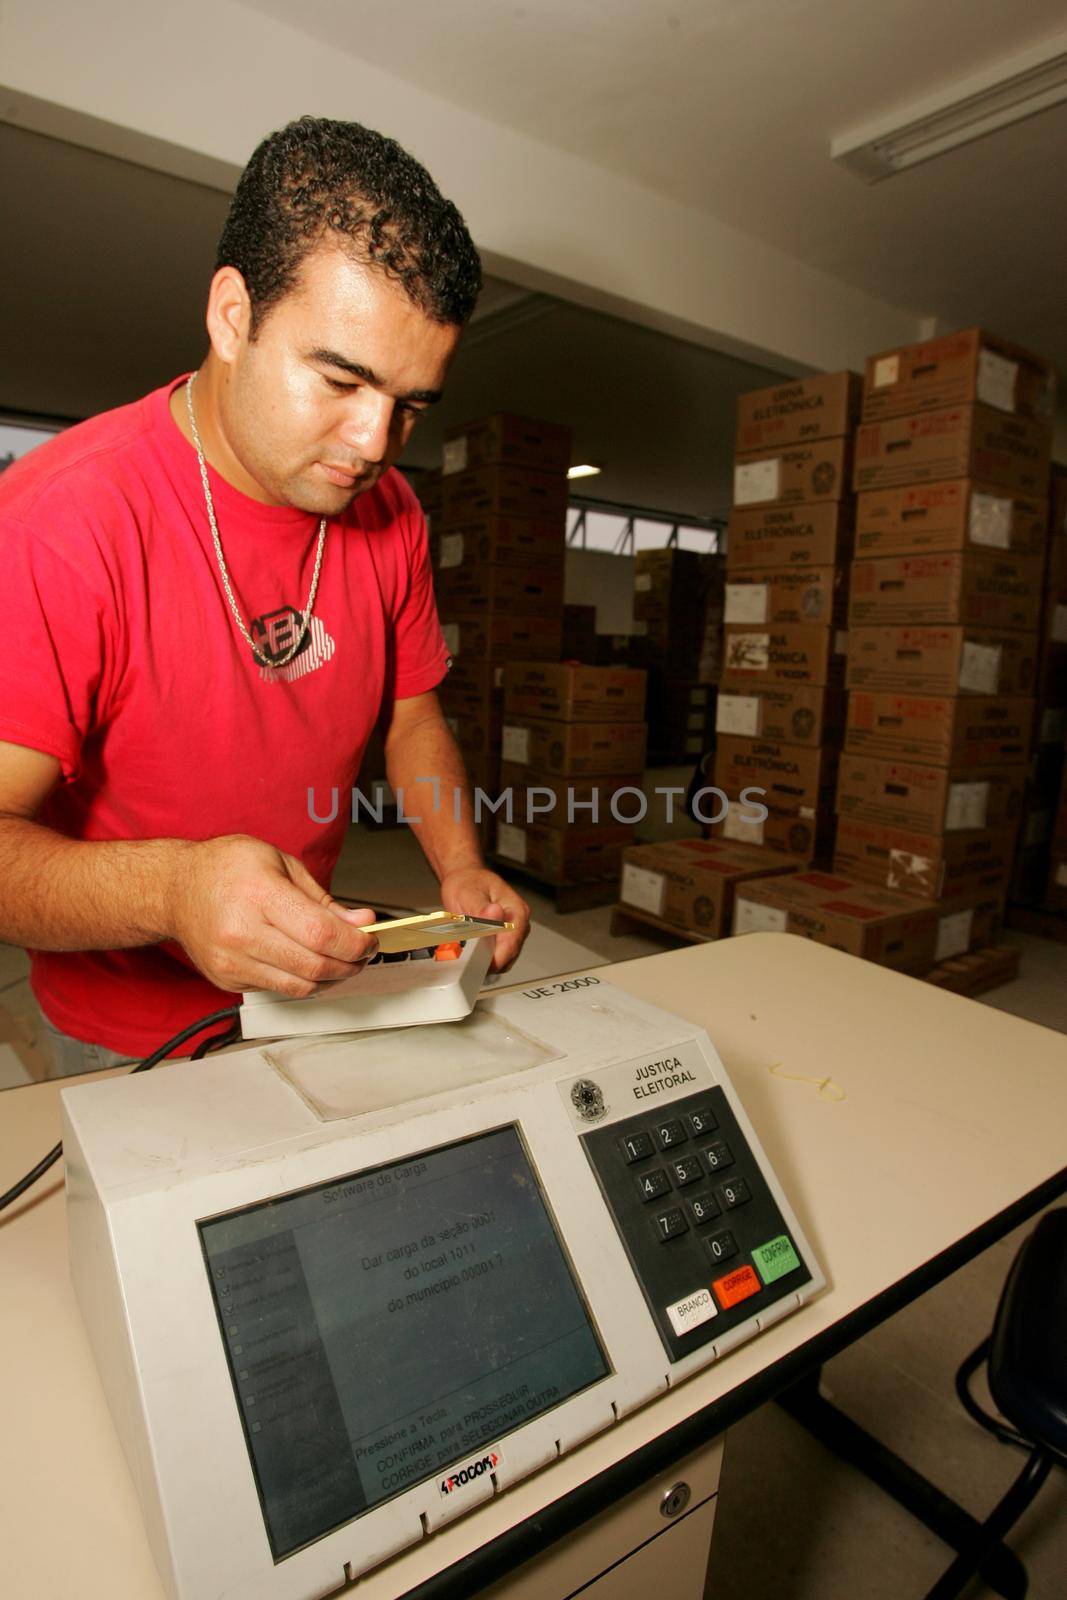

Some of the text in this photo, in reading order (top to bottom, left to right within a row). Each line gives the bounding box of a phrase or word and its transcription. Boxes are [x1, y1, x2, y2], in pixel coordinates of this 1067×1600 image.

[522, 976, 600, 999] UE 2000
[635, 1057, 682, 1081] JUSTIÇA
[633, 1070, 696, 1100] ELEITORAL
[693, 1116, 703, 1130] 3
[661, 1128, 672, 1144] 2
[627, 1141, 637, 1157] 1
[708, 1151, 718, 1166] 6
[377, 1174, 392, 1189] de
[394, 1161, 428, 1180] Carga
[675, 1165, 686, 1180] 5
[645, 1179, 654, 1194] 4
[725, 1188, 735, 1202] 9
[694, 1202, 704, 1217] 8
[660, 1217, 670, 1233] 7
[361, 1254, 384, 1271] Dar
[386, 1240, 419, 1262] carga
[420, 1234, 437, 1249] da
[438, 1221, 470, 1241] seção
[711, 1241, 722, 1256] 0
[403, 1266, 420, 1281] do
[421, 1253, 448, 1275] local
[387, 1298, 404, 1314] do
[405, 1274, 460, 1307] município
[677, 1292, 709, 1318] BRANCO
[376, 1384, 530, 1473] CONFIRMA para PROSSEGUIR
[381, 1453, 432, 1490] CORRIGE
[437, 1441, 461, 1461] para
[524, 1386, 560, 1414] OUTRA
[355, 1428, 408, 1461] Pressione
[410, 1422, 418, 1434] a
